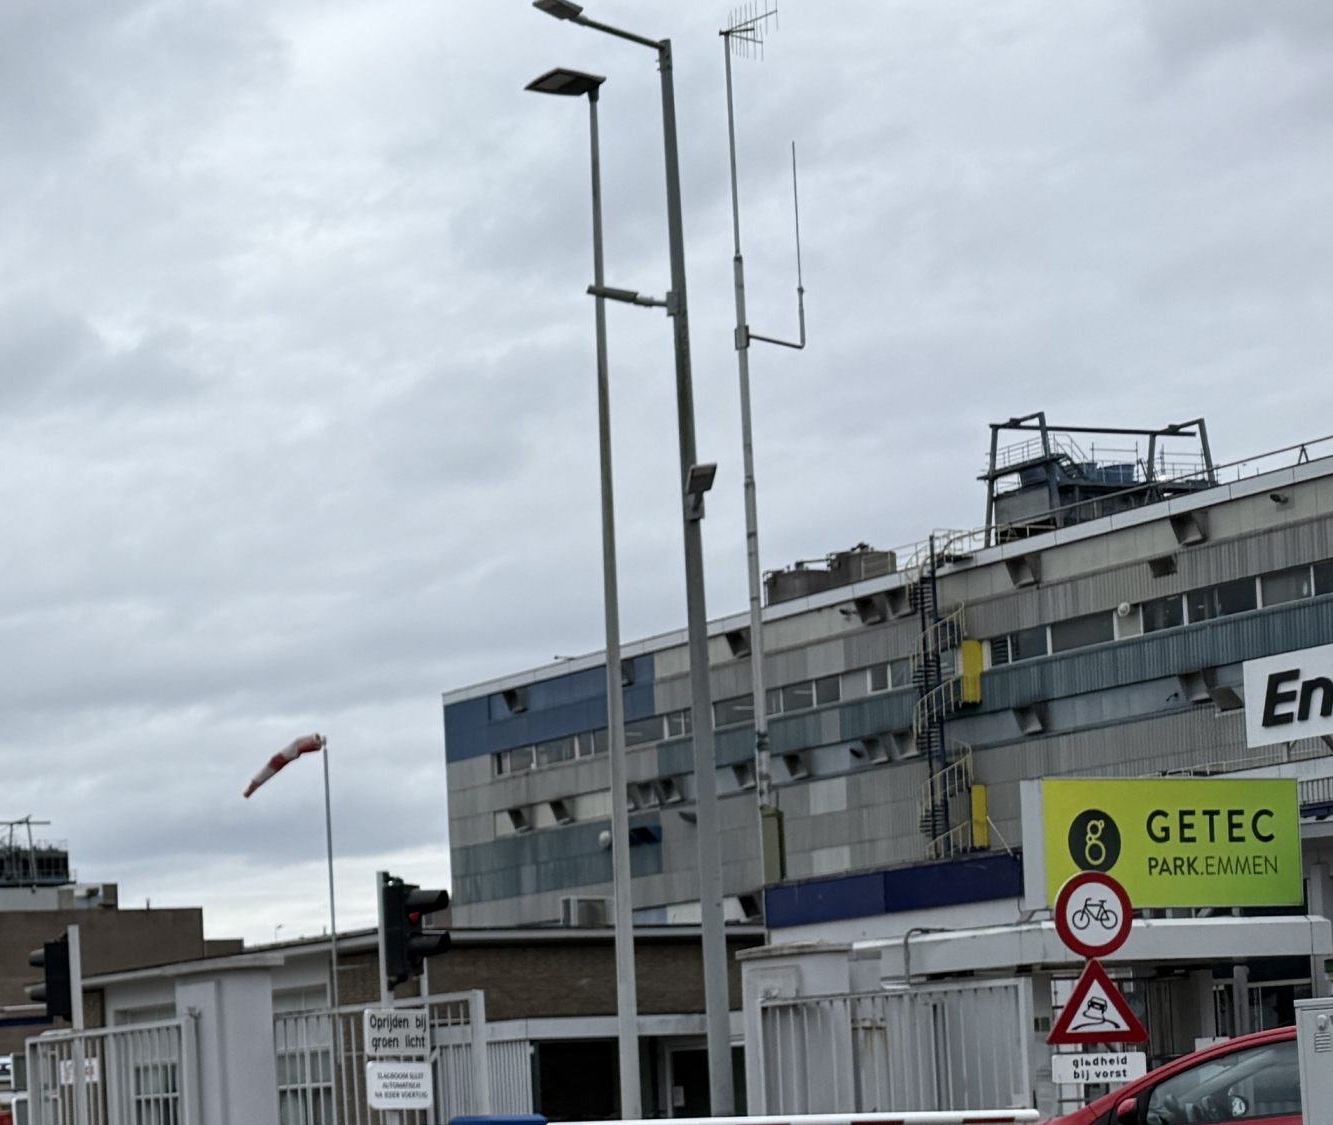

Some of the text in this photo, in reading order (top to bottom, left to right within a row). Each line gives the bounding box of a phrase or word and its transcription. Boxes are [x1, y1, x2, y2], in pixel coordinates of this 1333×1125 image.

[1146, 809, 1275, 844] GETEC
[1147, 855, 1279, 876] PARK.EMMEN
[369, 1014, 427, 1033] Oprijden bij
[371, 1034, 425, 1052] groen licht
[1072, 1056, 1127, 1069] gladheid
[1073, 1068, 1127, 1081] bij vorst
